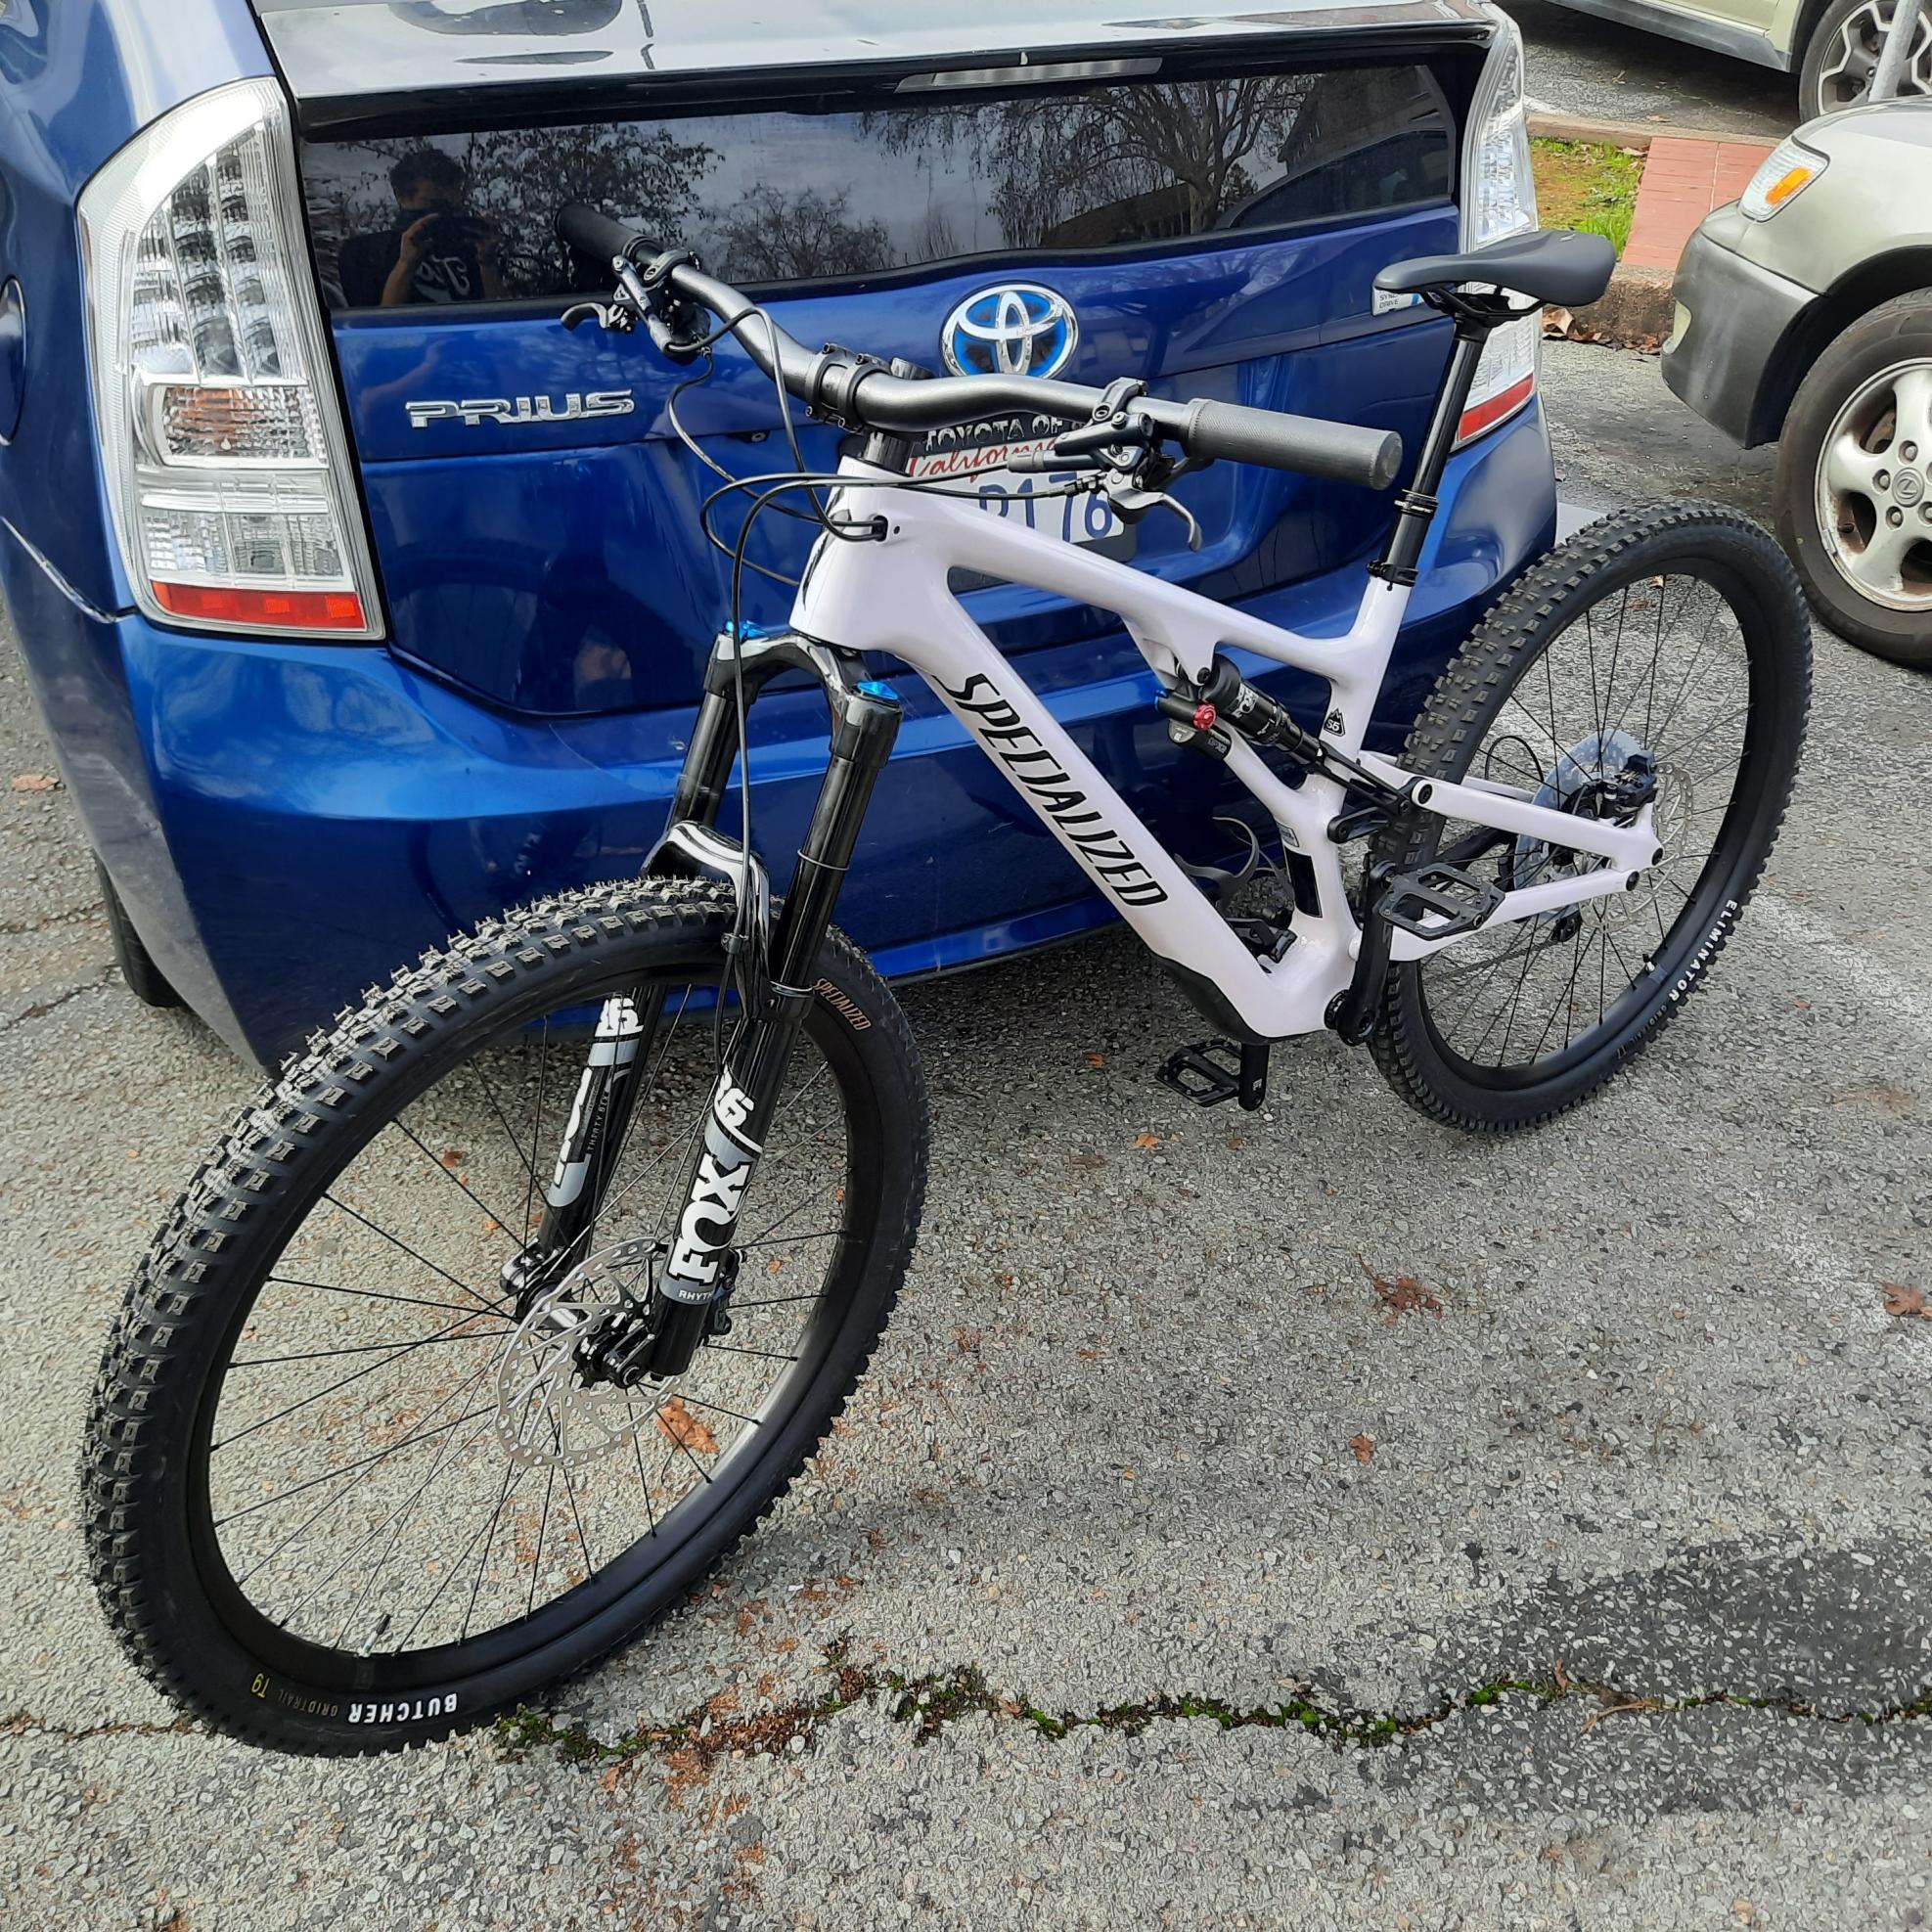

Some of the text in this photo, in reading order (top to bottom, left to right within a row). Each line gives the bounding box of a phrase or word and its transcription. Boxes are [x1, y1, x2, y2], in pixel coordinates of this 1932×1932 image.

[406, 389, 636, 428] PRIUS
[924, 418, 1026, 451] TOYOTA
[931, 672, 1170, 908] SPECIALIZED
[1668, 899, 1738, 1002] ELIMINATOR
[813, 977, 873, 1031] SPECIALIZED
[668, 1153, 751, 1286] FOX
[250, 1673, 271, 1698] T9
[347, 1692, 458, 1724] BUTCHER
